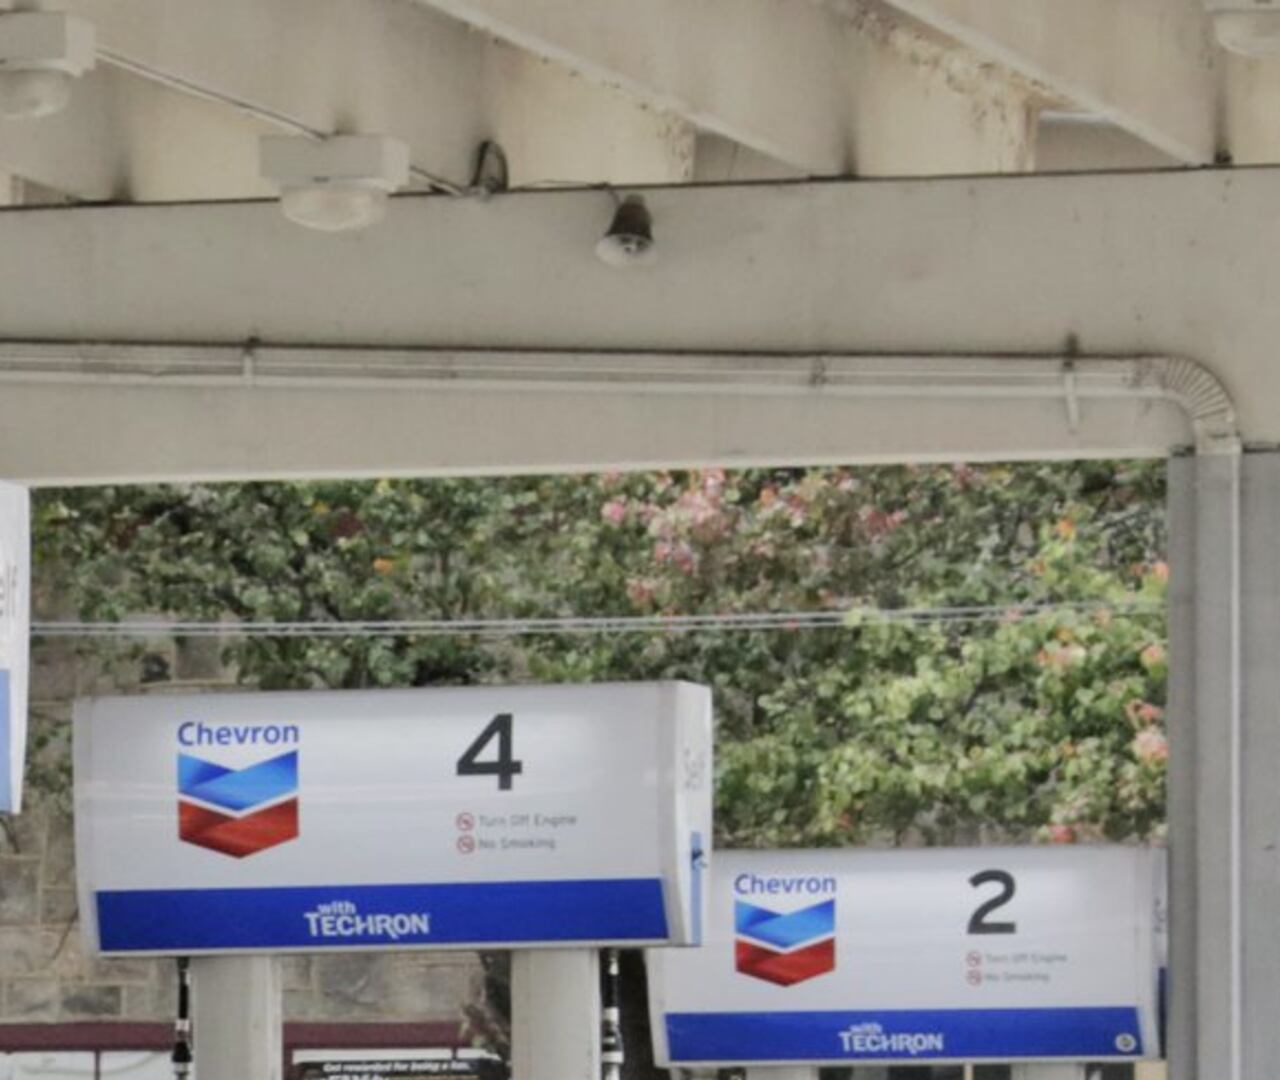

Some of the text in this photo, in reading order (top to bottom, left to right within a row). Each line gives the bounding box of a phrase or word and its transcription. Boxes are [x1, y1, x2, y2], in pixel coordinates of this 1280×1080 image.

[177, 721, 299, 746] Chevron
[456, 713, 523, 791] 4
[735, 873, 837, 896] Chevron
[318, 901, 357, 915] with
[967, 869, 1017, 934] 2
[303, 912, 430, 939] TECHRON
[837, 1032, 944, 1054] TECHRON
